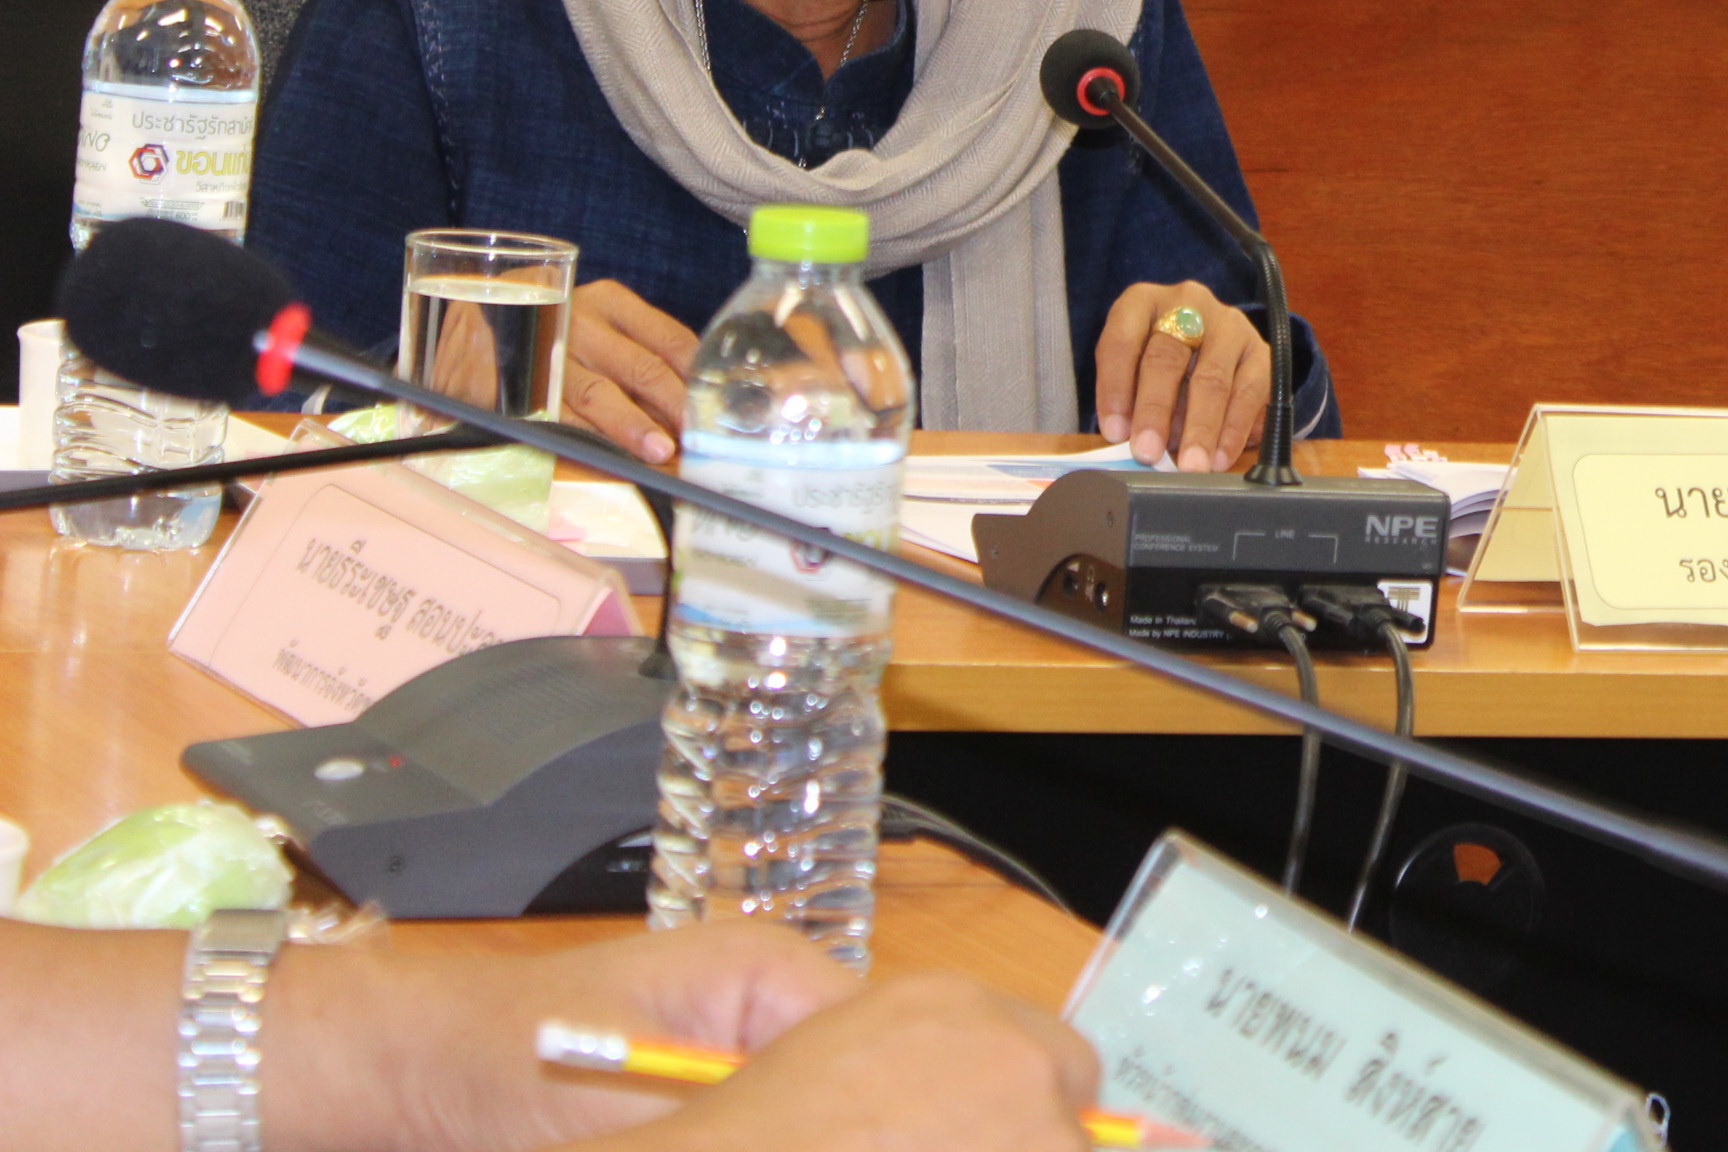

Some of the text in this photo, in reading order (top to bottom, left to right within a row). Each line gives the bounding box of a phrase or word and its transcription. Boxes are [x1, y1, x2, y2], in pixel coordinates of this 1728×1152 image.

[1366, 515, 1439, 538] NPE
[1275, 530, 1295, 539] LINE
[1130, 616, 1152, 624] Made
[1166, 616, 1196, 625] Thailan
[1129, 630, 1150, 638] Made
[1163, 629, 1180, 638] NPE
[1183, 630, 1224, 639] INDUSTRY
